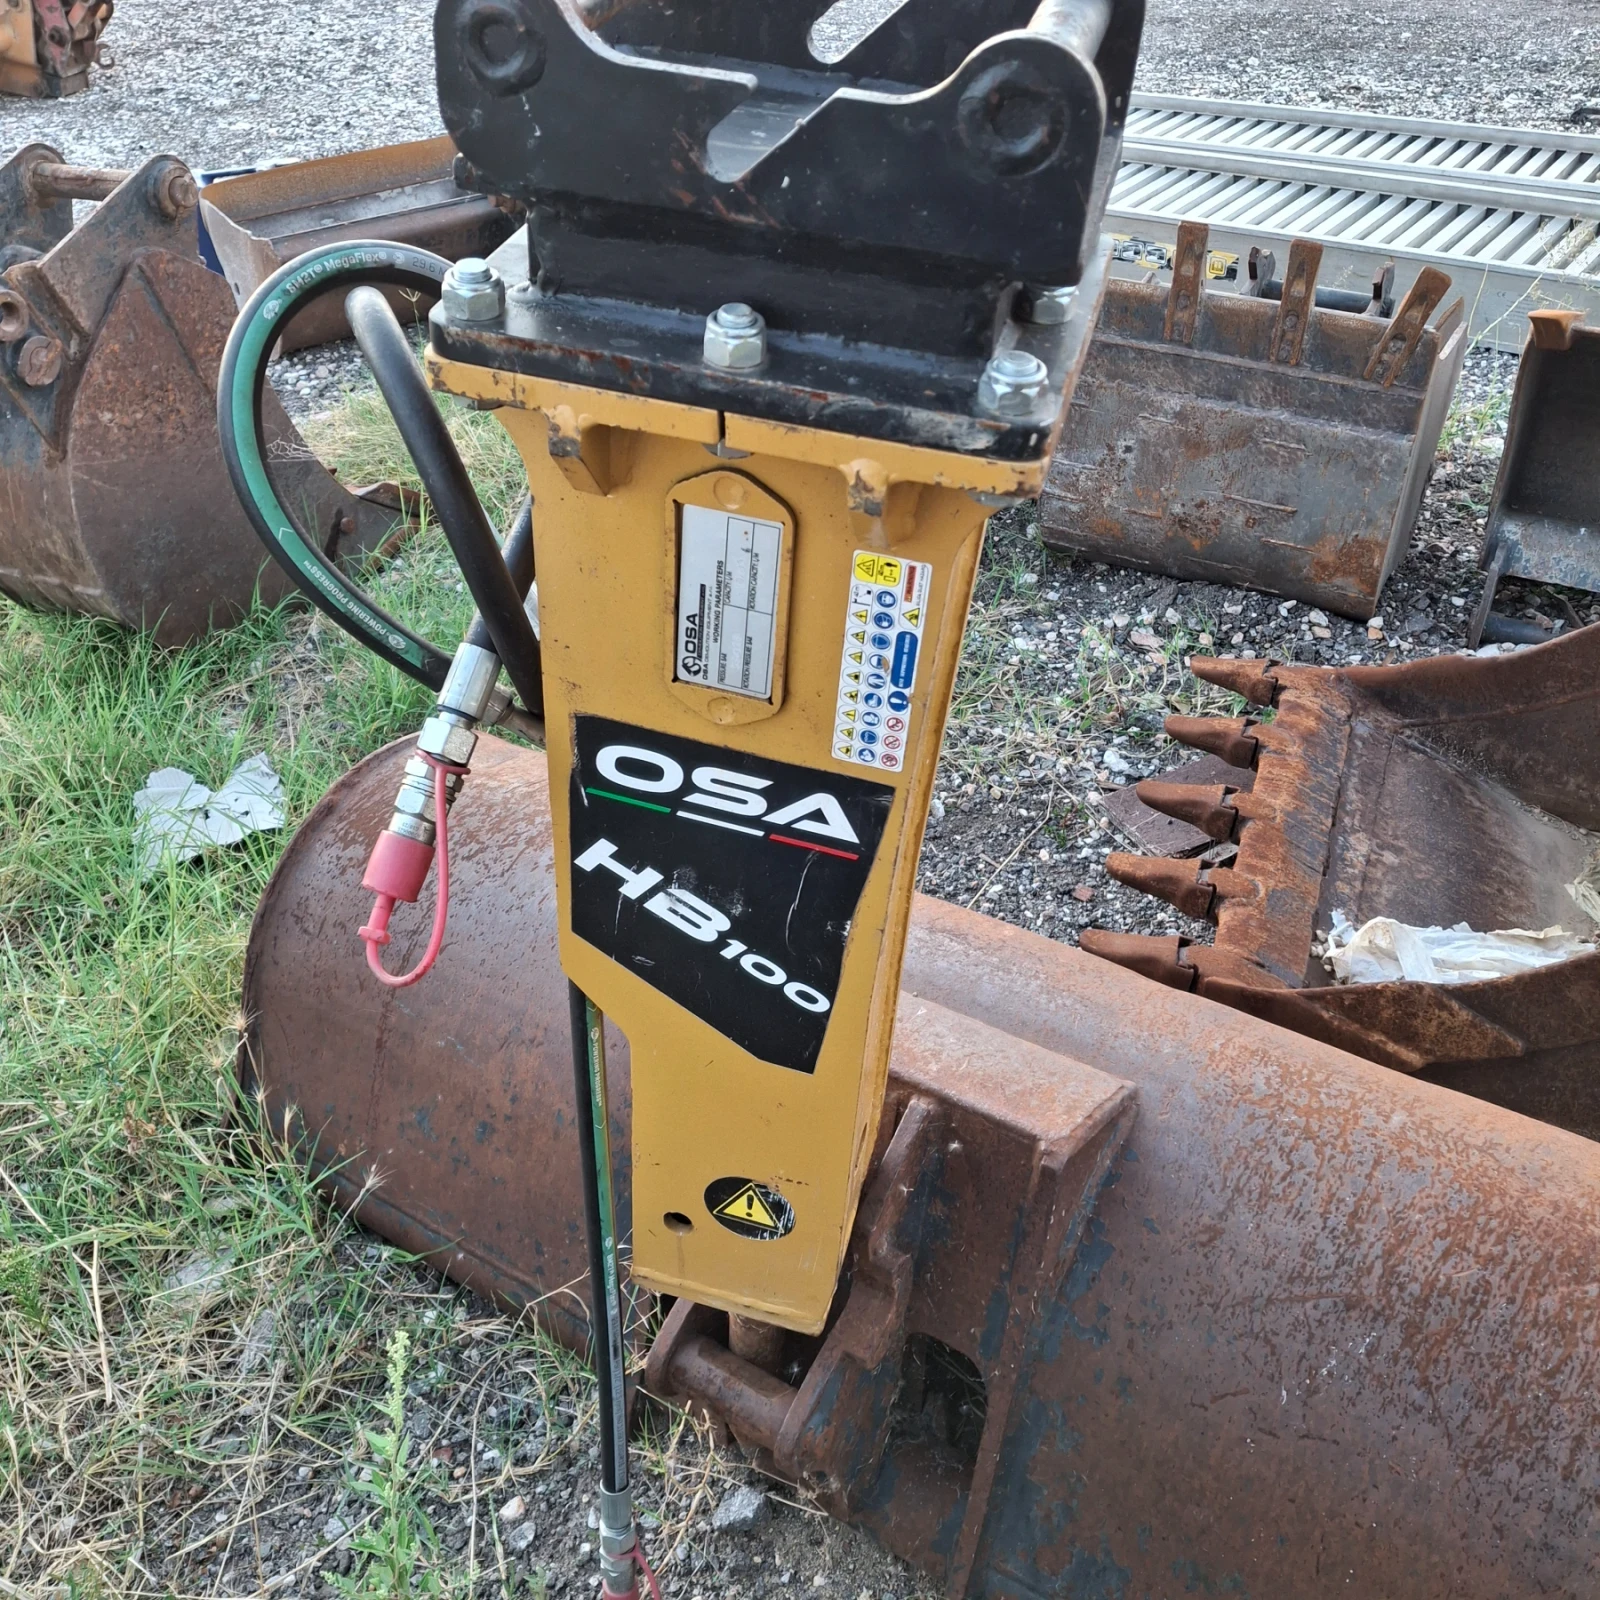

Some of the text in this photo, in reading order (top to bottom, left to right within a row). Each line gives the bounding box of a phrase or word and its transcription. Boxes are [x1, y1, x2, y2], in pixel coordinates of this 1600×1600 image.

[412, 256, 435, 272] 29.6
[346, 601, 387, 635] POWERING
[712, 560, 724, 644] WORKING PARAMETERS
[684, 613, 698, 654] OSA
[595, 745, 860, 844] OSA
